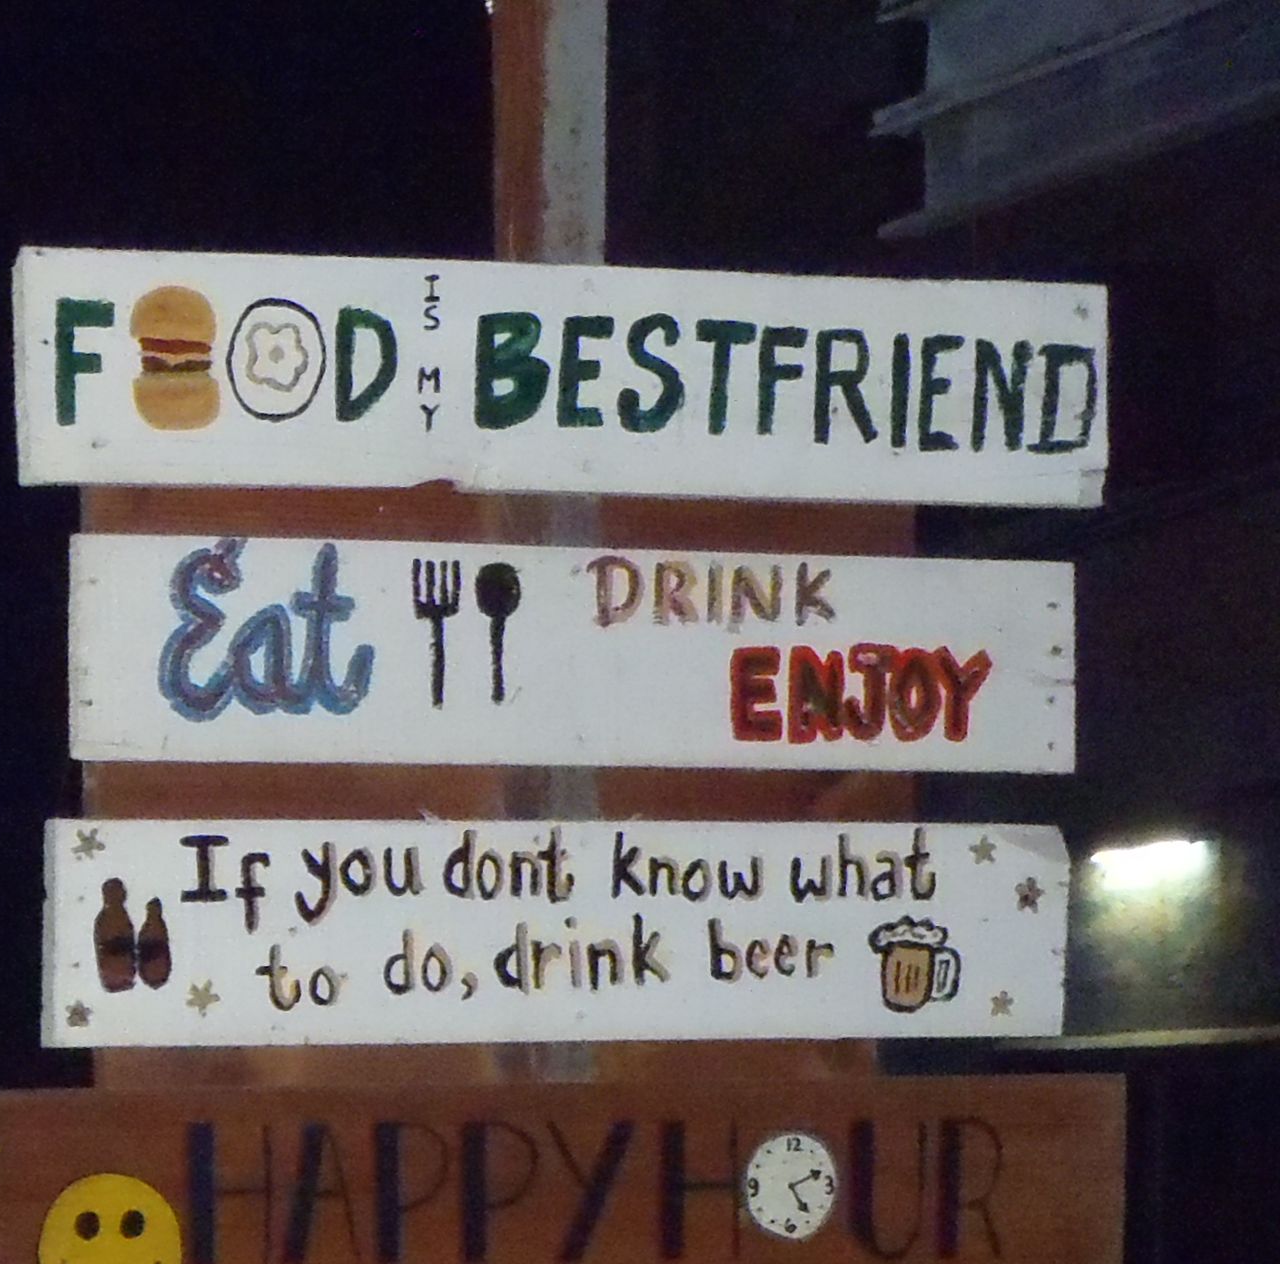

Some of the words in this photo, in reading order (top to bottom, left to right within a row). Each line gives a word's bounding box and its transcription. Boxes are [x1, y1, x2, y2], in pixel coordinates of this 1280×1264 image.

[474, 311, 1096, 453] BESTFRIEND
[585, 553, 838, 627] DRINK
[728, 643, 992, 745] ENJOY
[178, 834, 268, 932] If
[293, 840, 422, 922] you
[611, 830, 764, 903] know
[790, 838, 940, 904] what
[255, 946, 340, 1013] to
[493, 921, 665, 994] drink
[708, 918, 836, 980] beer
